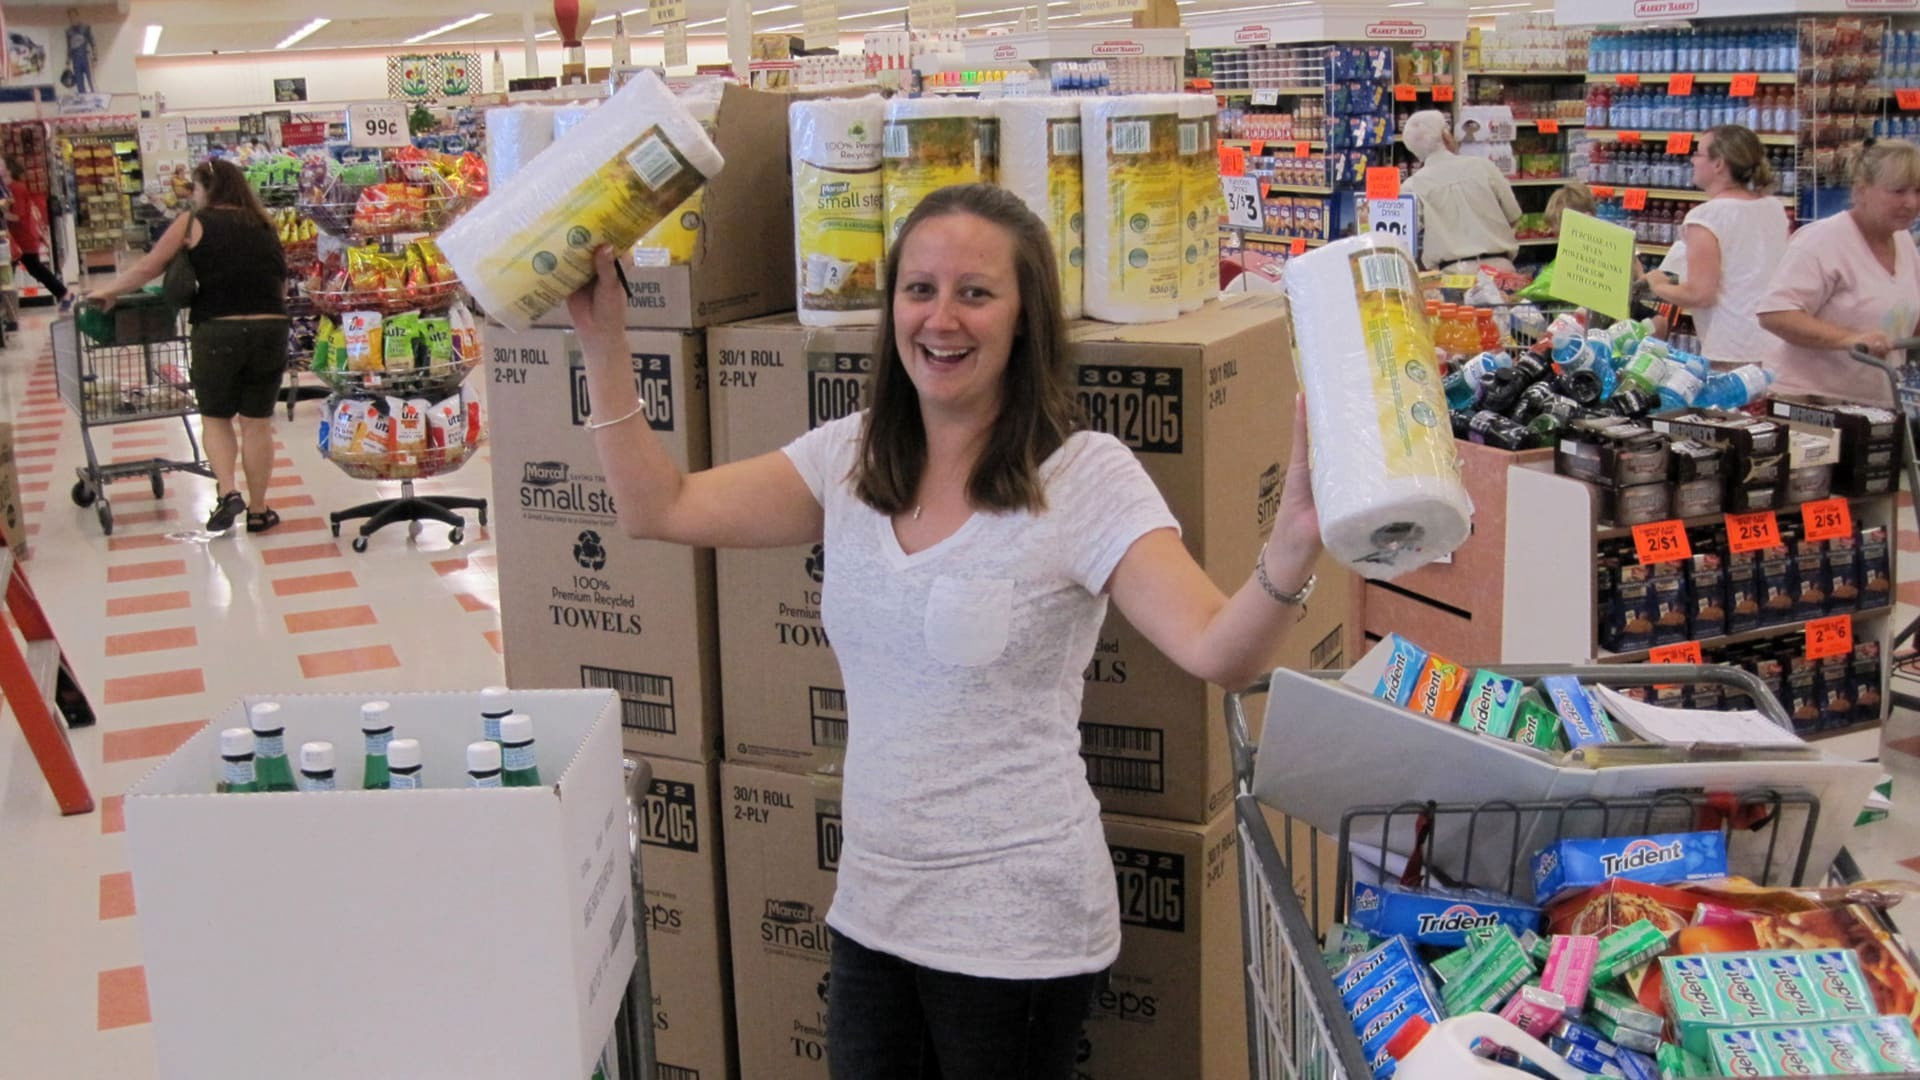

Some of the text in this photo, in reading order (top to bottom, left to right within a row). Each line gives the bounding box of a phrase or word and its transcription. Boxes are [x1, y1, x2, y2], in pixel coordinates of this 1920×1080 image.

[818, 192, 860, 208] small
[830, 267, 838, 278] 2
[628, 282, 660, 294] PAPER
[627, 296, 666, 308] TOWELS
[494, 348, 549, 364] 30/1 ROLL
[719, 350, 784, 367] 30/1 ROLL
[494, 368, 526, 384] 2-PLY
[719, 370, 757, 387] 2-PLY
[526, 463, 565, 480] Marcal
[520, 482, 617, 514] small ste
[1258, 493, 1281, 525] sma
[1814, 513, 1842, 528] 2/$1
[1740, 524, 1769, 539] 2/$1
[1648, 536, 1678, 552] 2/$1
[572, 576, 610, 590] 100%
[552, 586, 635, 609] Premium Recycled
[804, 590, 822, 606] 10
[548, 604, 642, 636] TOWELS
[775, 622, 830, 648] TOW
[1424, 670, 1442, 716] rident
[734, 786, 794, 808] 30/1 ROLL
[734, 806, 769, 824] 2-PLY
[1602, 840, 1683, 877] Trident
[766, 902, 810, 920] Marcal
[1420, 913, 1498, 934] Trident
[761, 922, 830, 952] small
[1340, 950, 1386, 996] rident
[1350, 978, 1396, 1020] rident
[1679, 971, 1718, 1018] Trident
[1726, 971, 1768, 1018] Trident
[1775, 969, 1815, 1016] Trident
[1820, 965, 1864, 1012] Trident
[1101, 989, 1158, 1019] eps
[1360, 1000, 1406, 1046] rident
